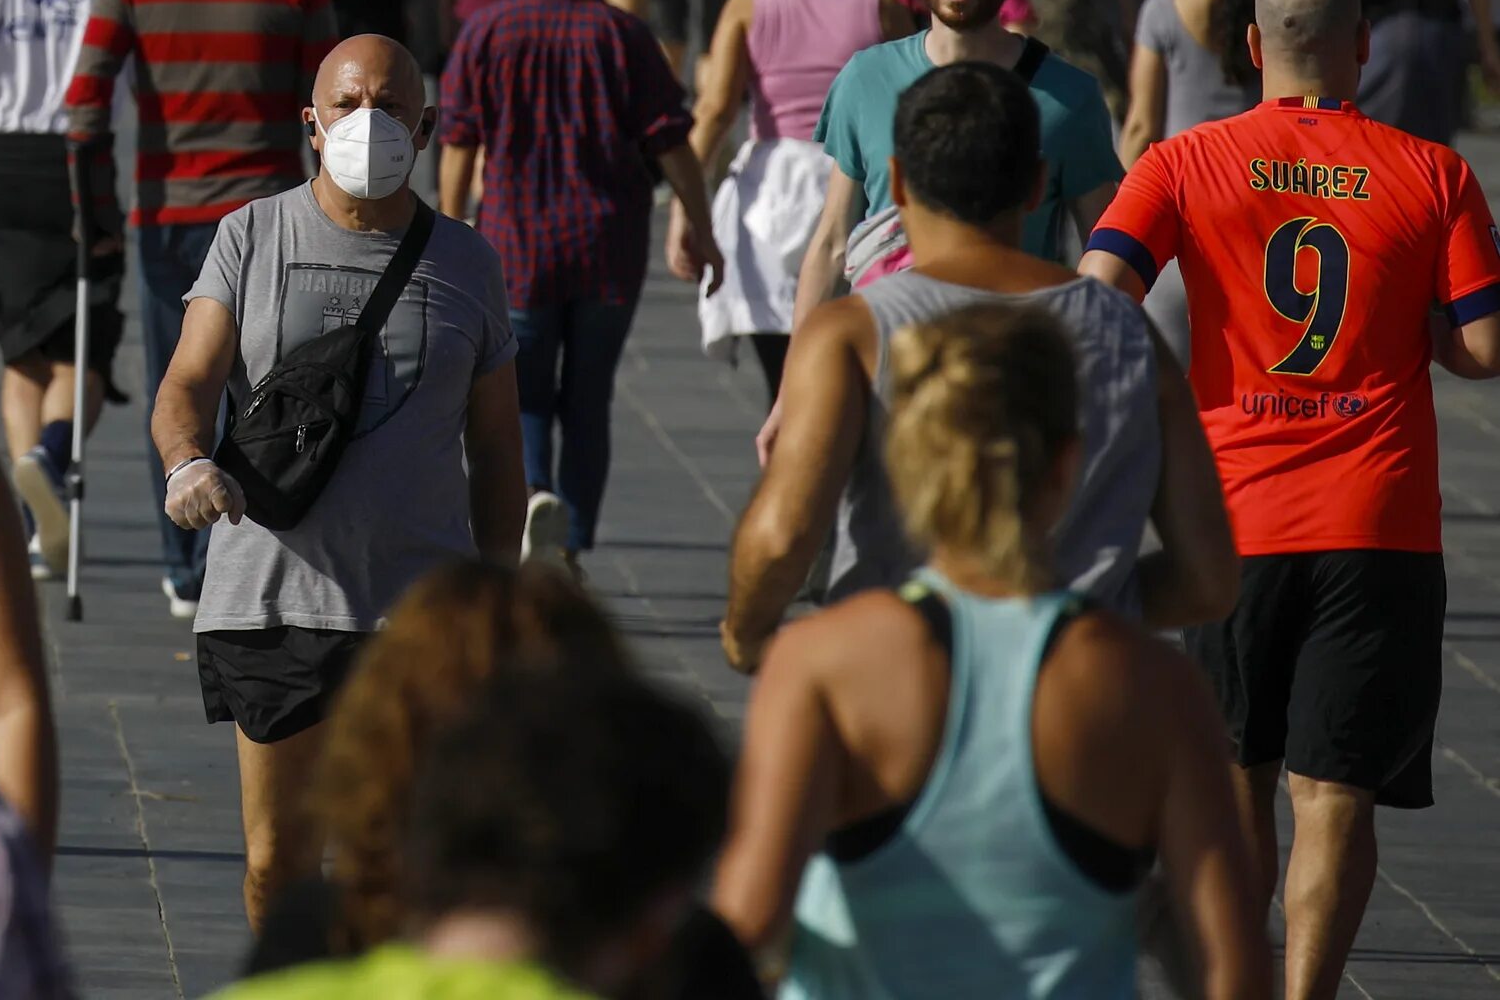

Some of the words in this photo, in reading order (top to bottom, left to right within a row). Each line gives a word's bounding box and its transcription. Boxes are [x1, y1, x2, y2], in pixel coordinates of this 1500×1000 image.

[1250, 158, 1370, 200] SUÁREZ
[1264, 217, 1350, 376] 9
[1242, 388, 1330, 418] unicef
